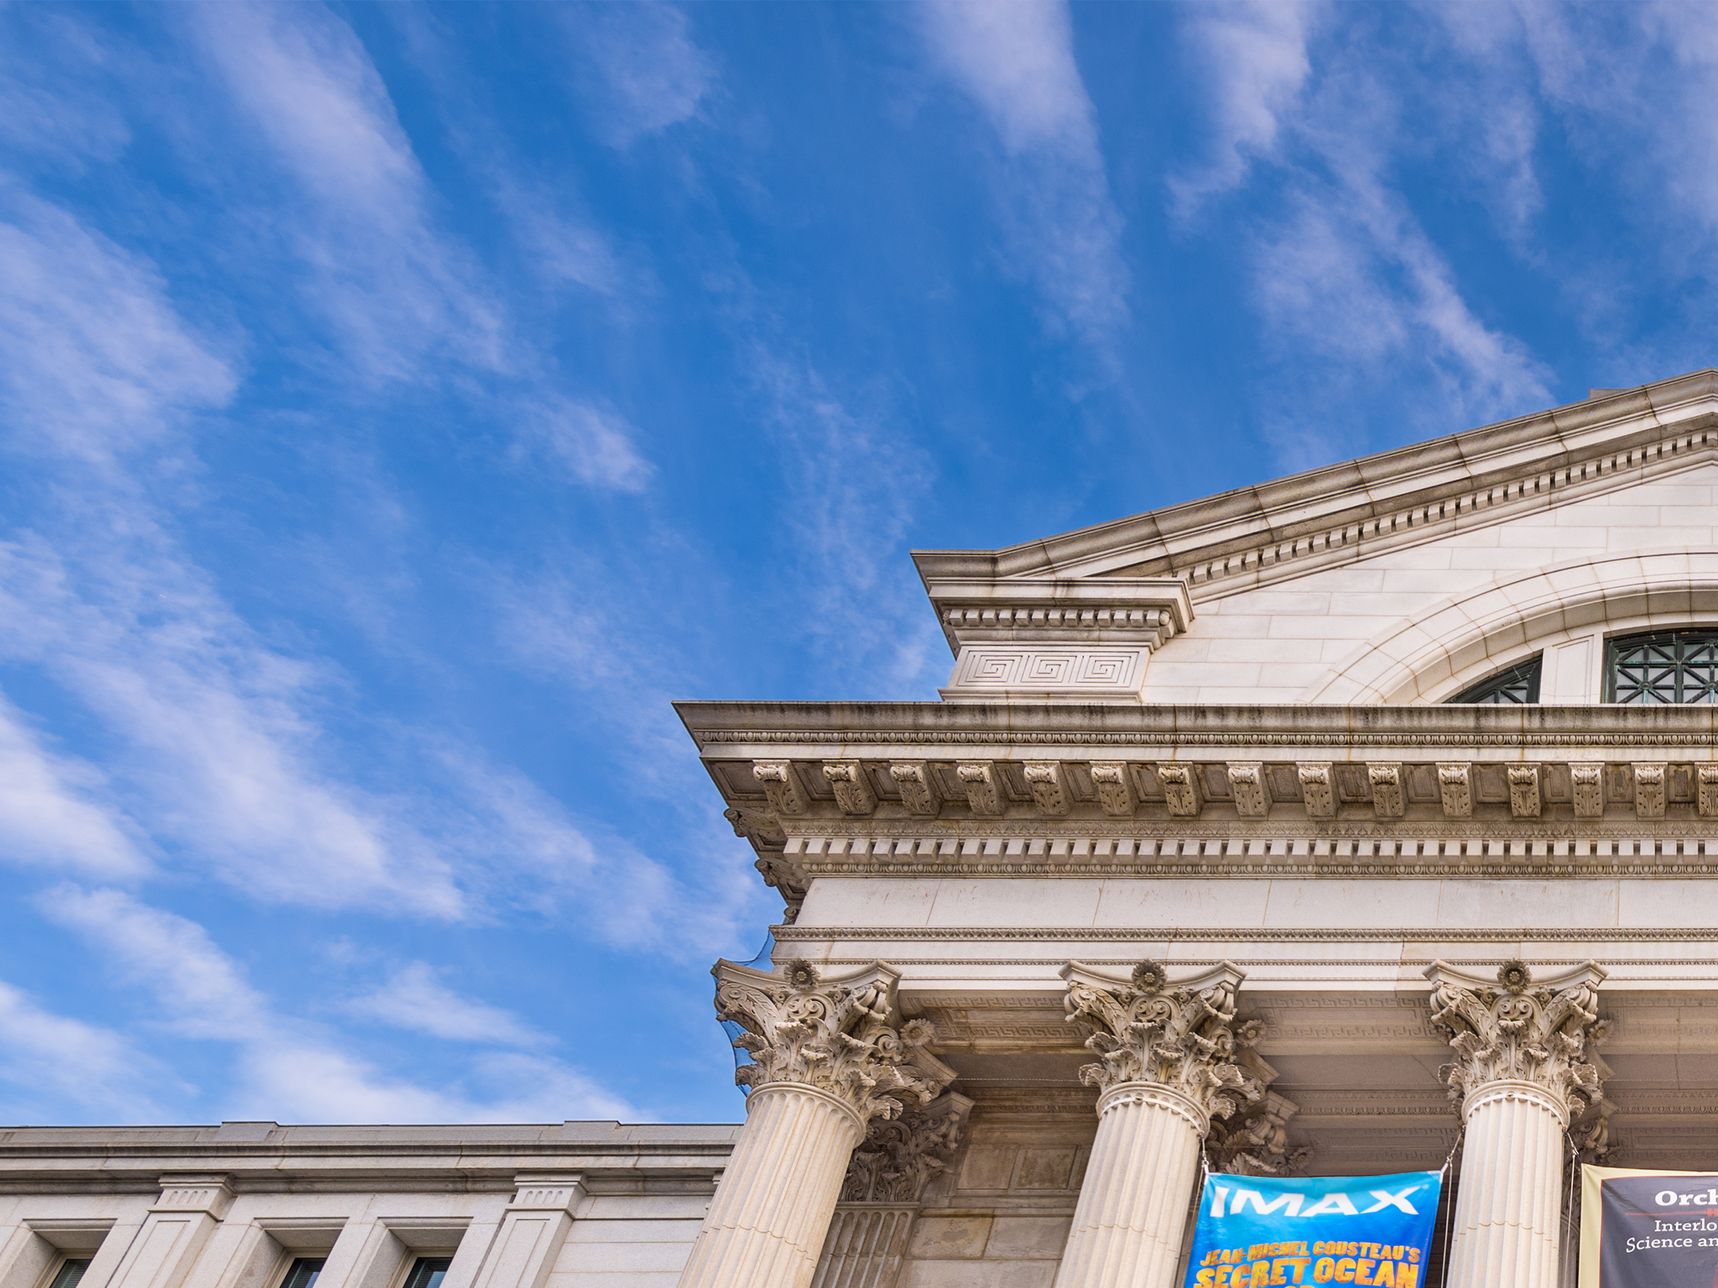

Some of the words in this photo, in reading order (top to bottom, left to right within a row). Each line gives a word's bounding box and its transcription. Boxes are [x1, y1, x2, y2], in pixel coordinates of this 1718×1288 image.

[1200, 1241, 1310, 1267] JEAN-MICHEL
[1312, 1241, 1421, 1263] COUSTEAU'S
[1626, 1236, 1693, 1253] Science
